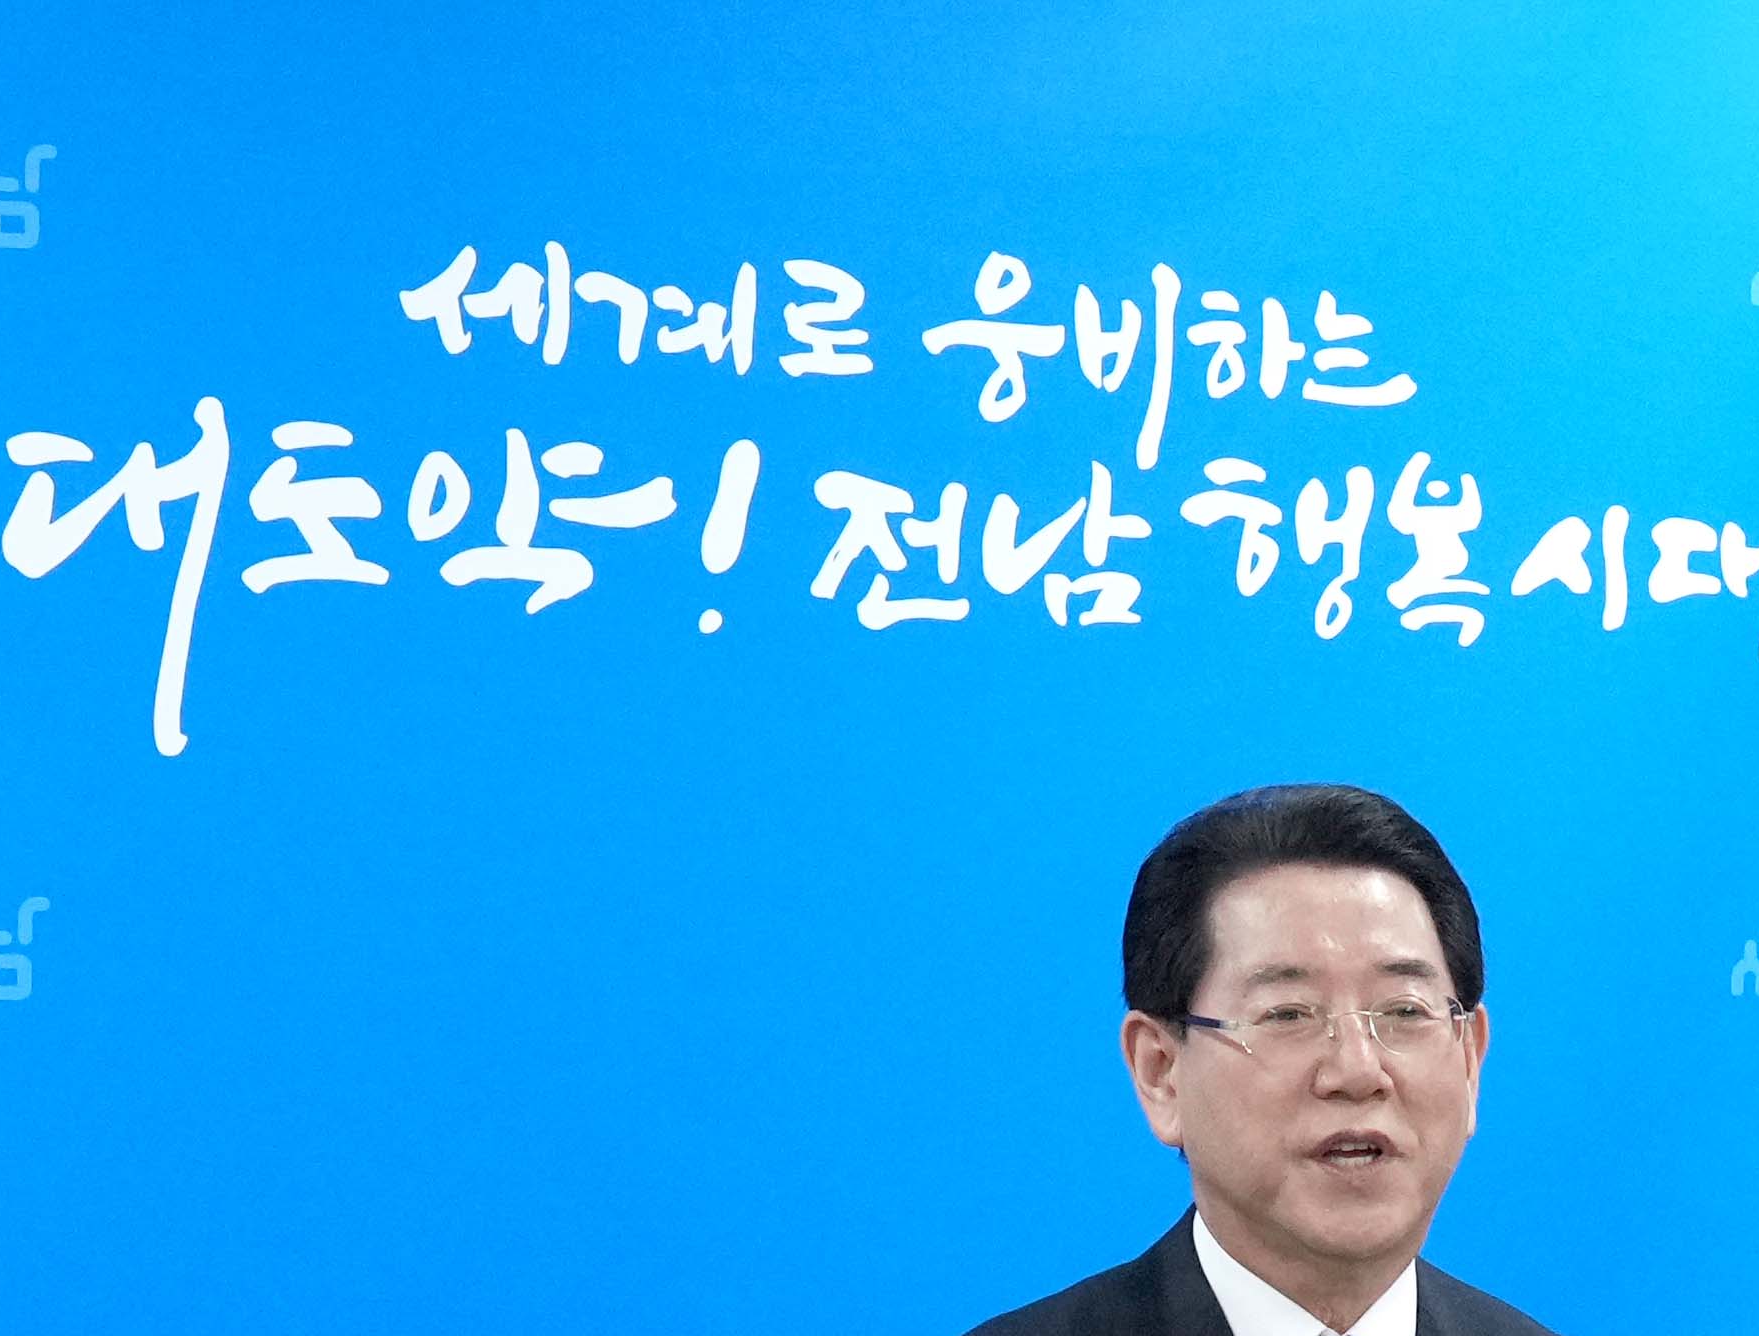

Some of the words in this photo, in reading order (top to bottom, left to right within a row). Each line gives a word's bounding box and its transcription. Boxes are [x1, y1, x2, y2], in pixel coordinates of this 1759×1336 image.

[399, 241, 873, 377] 세계로
[921, 249, 1418, 471] 웅비하는
[1, 396, 760, 758] 대도약!
[810, 463, 1153, 628] 전남
